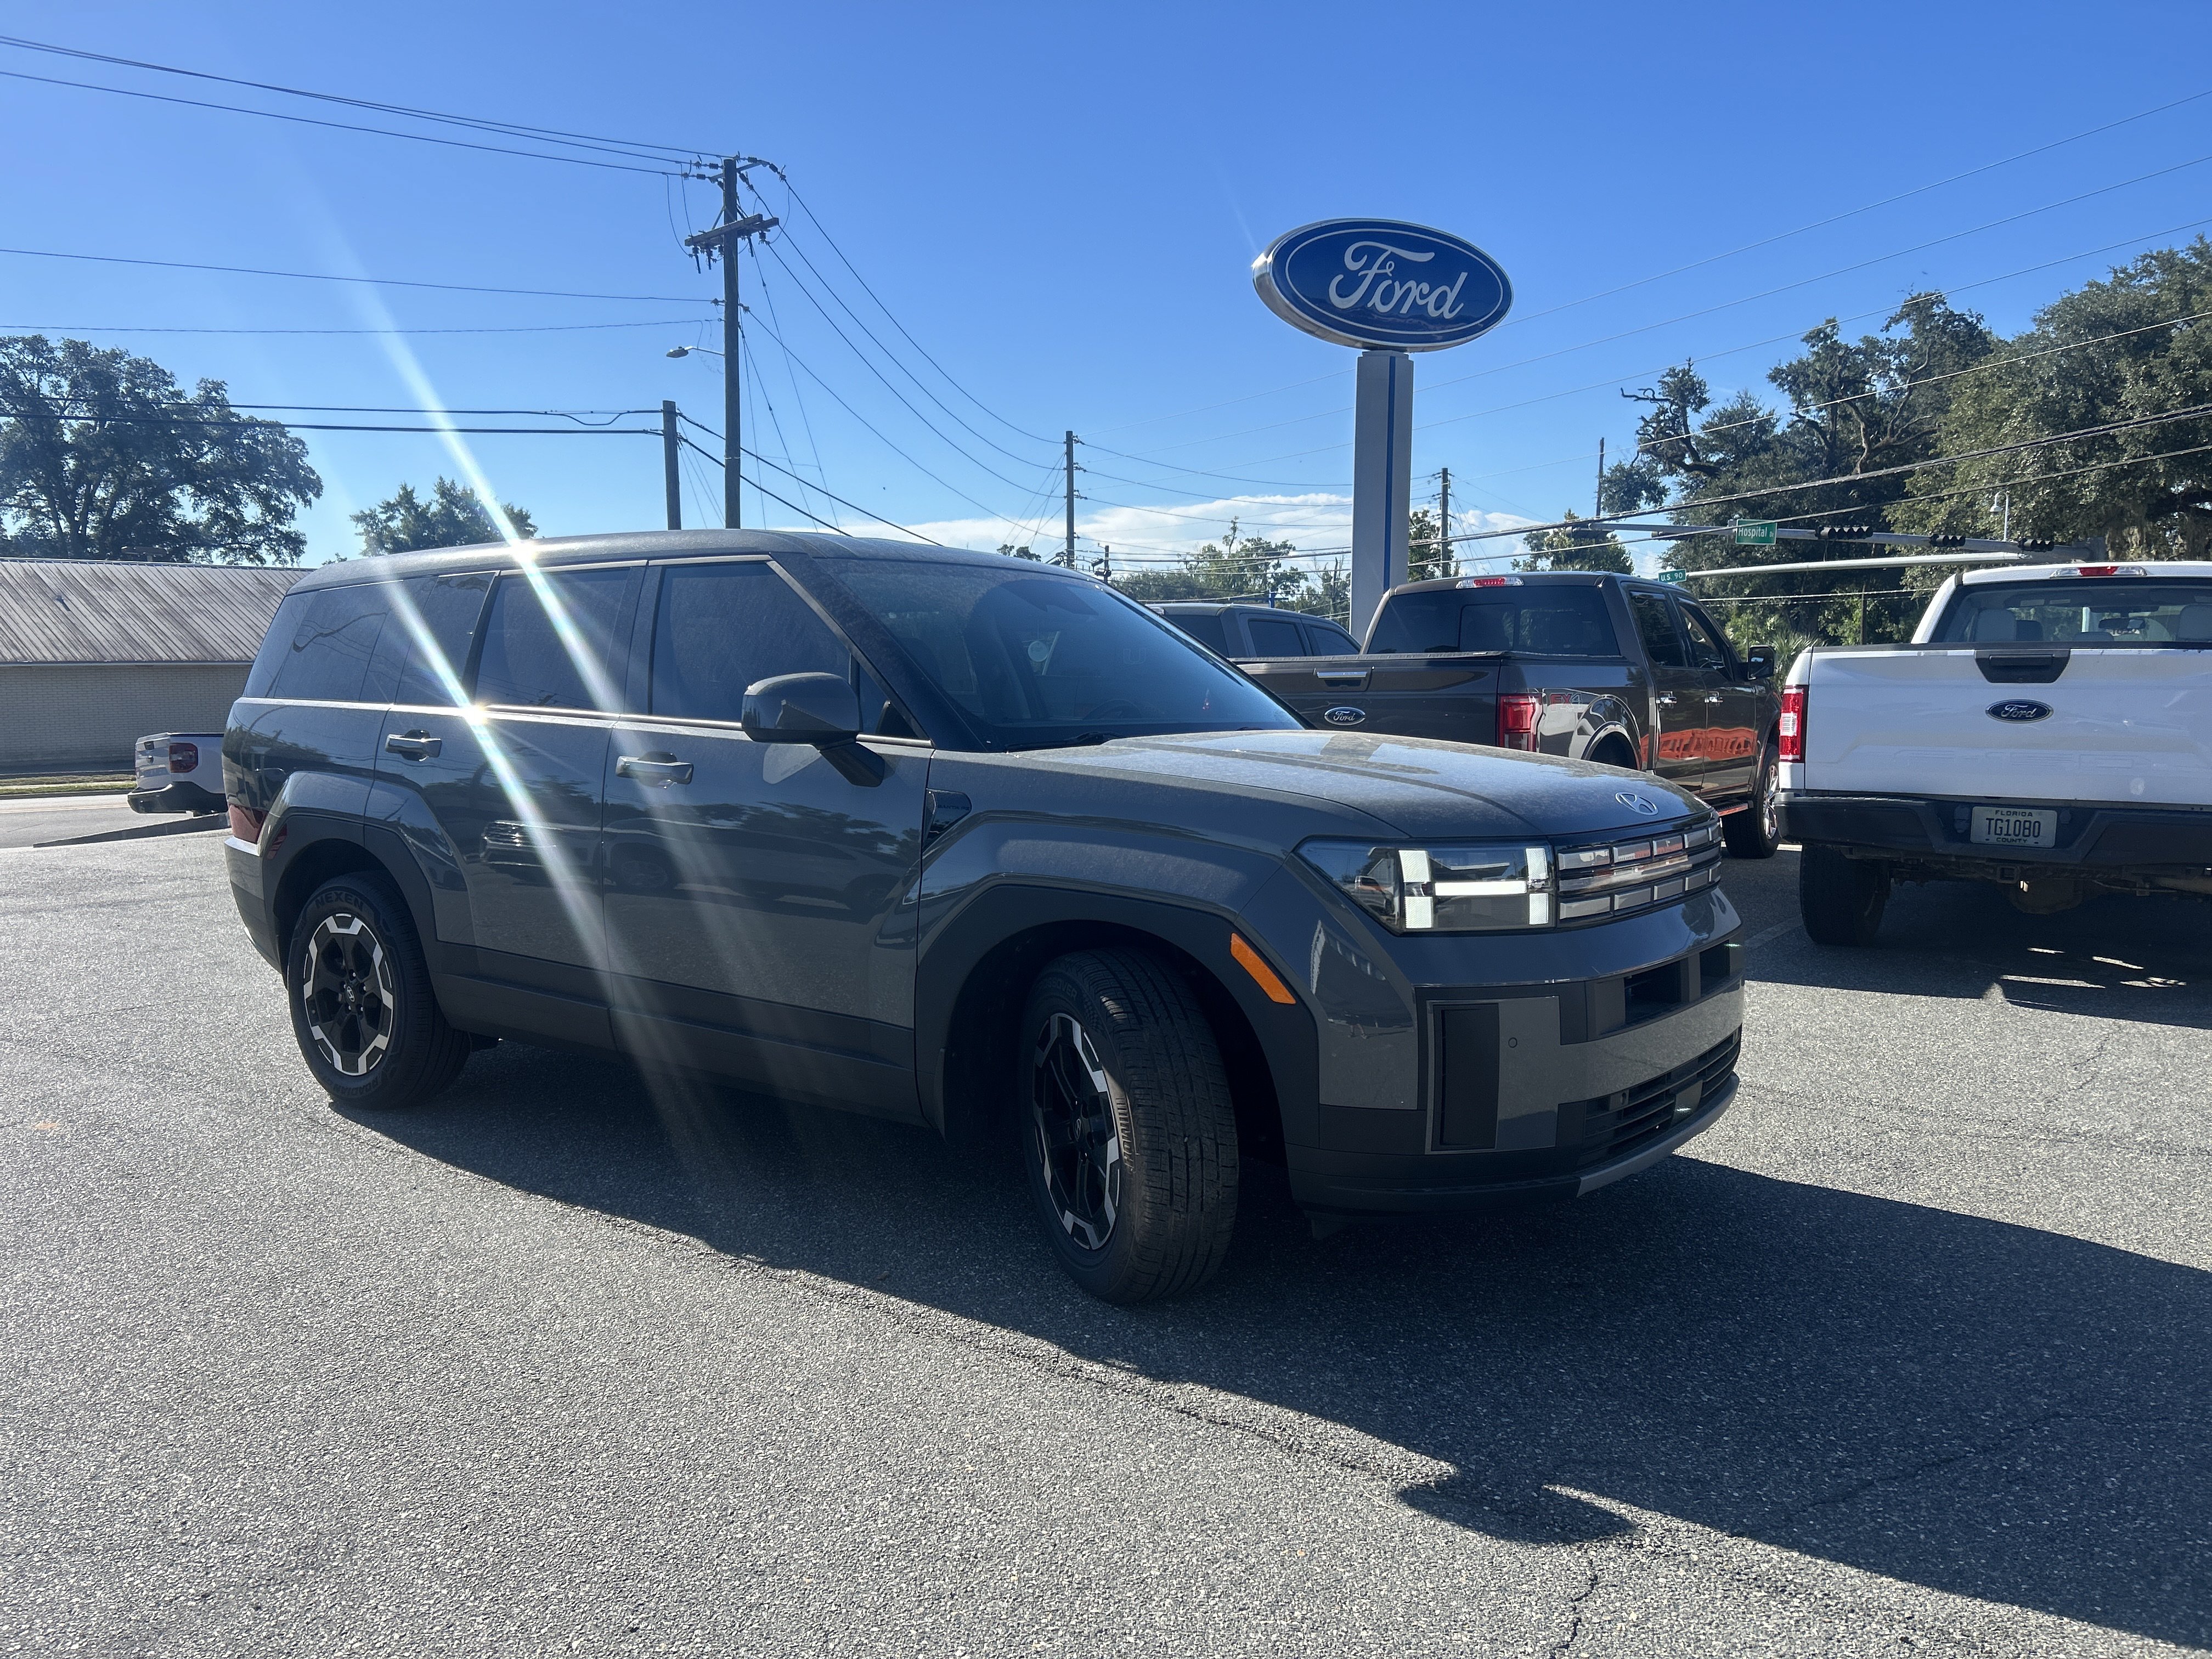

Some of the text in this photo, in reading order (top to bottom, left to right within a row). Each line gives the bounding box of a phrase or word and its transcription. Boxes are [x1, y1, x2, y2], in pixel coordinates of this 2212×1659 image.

[1328, 241, 1468, 319] Ford
[1738, 526, 1768, 539] Hospital
[1661, 573, 1672, 582] U.S.
[1333, 710, 1356, 721] Ford
[2000, 704, 2037, 718] Ford
[314, 891, 364, 912] NEXEN
